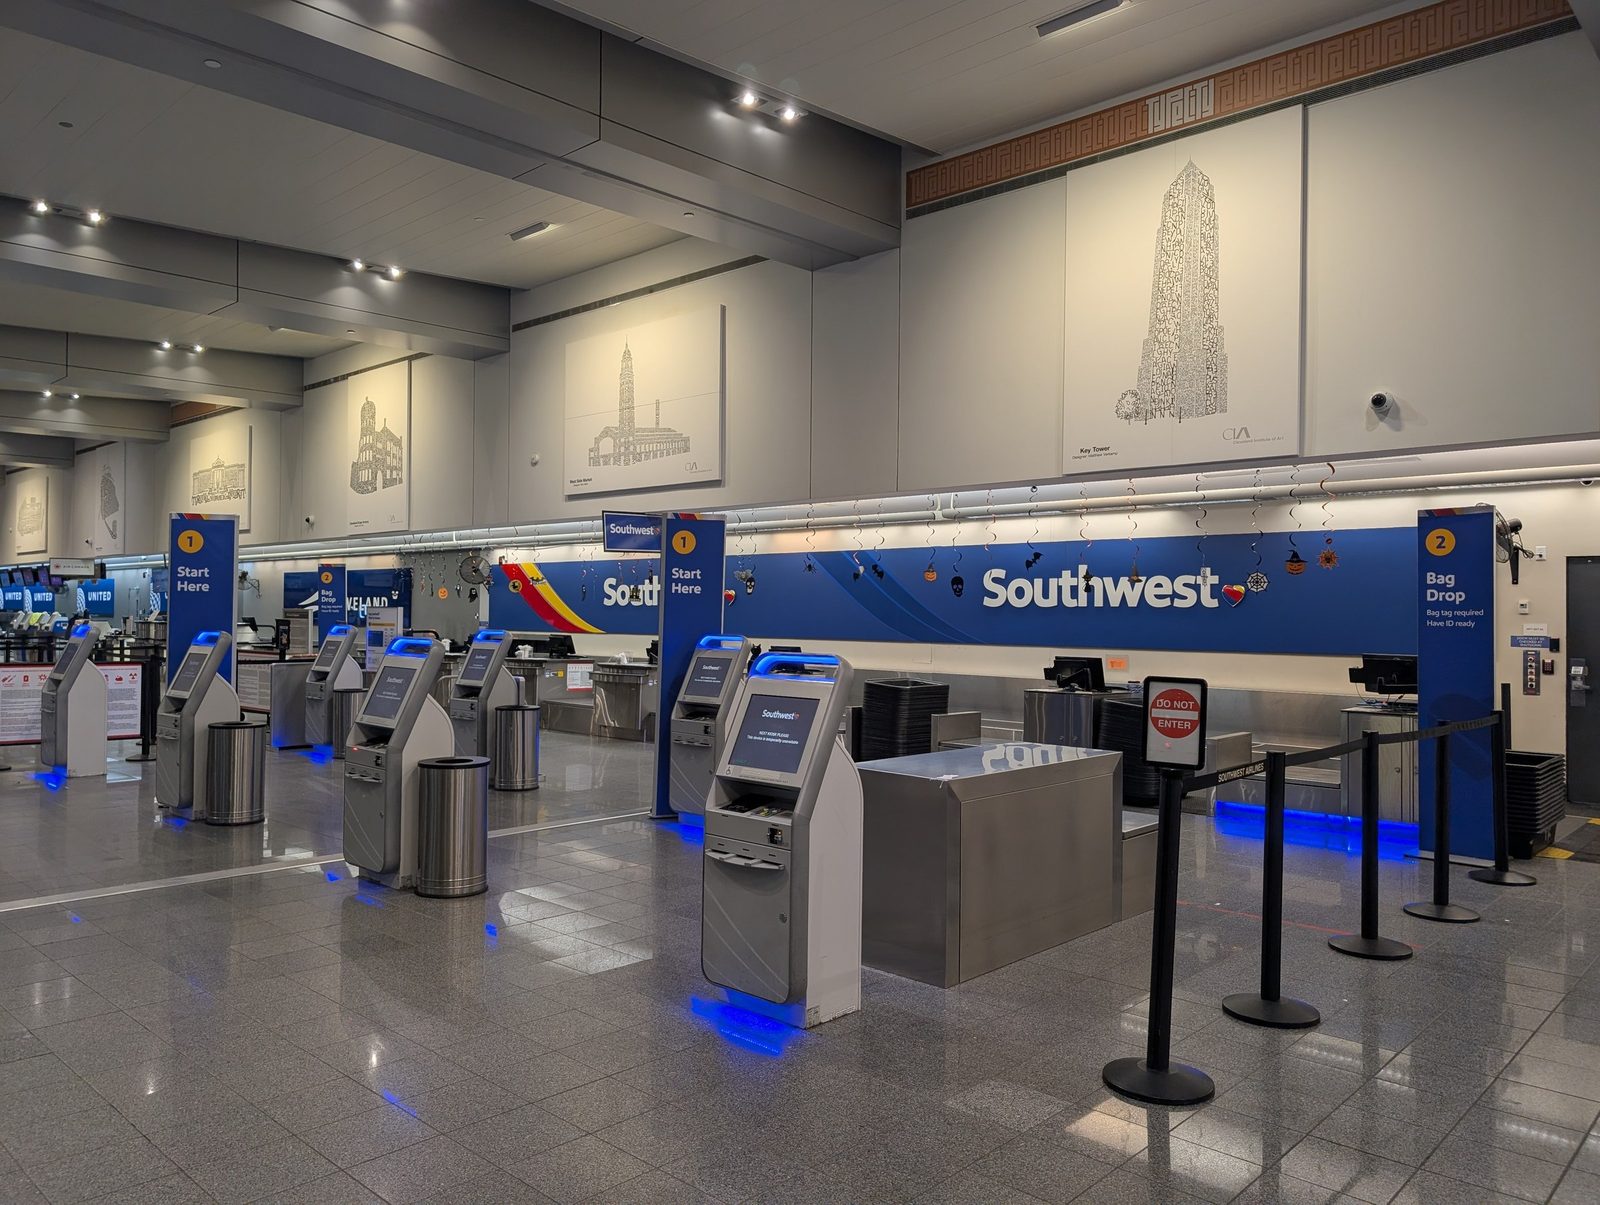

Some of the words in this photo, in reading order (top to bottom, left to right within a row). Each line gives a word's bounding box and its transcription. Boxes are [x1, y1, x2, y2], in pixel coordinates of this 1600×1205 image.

[609, 523, 655, 535] Southwest
[187, 536, 193, 547] 1
[681, 536, 687, 548] 1
[1435, 535, 1446, 549] 2
[177, 566, 210, 577] Start
[671, 567, 702, 579] Start
[1426, 571, 1455, 588] Bag
[177, 580, 210, 592] Here
[671, 582, 702, 594] Here
[982, 564, 1219, 608] Southwest
[5, 591, 22, 601] UNITED
[34, 592, 53, 602] UNITED
[88, 591, 112, 601] UNITED
[321, 589, 332, 597] Bag
[1426, 589, 1466, 605] Drop
[321, 596, 336, 604] Drop
[1426, 609, 1440, 617] Bag
[1441, 610, 1453, 618] tag
[1453, 609, 1484, 618] required
[1455, 620, 1476, 628] ready
[1156, 699, 1171, 708] DO
[1173, 700, 1195, 709] NOT
[761, 709, 795, 720] Southwest
[1158, 719, 1191, 729] ENTER
[1218, 767, 1245, 783] SOUTHWEST
[1245, 762, 1265, 774] AIRLINES
